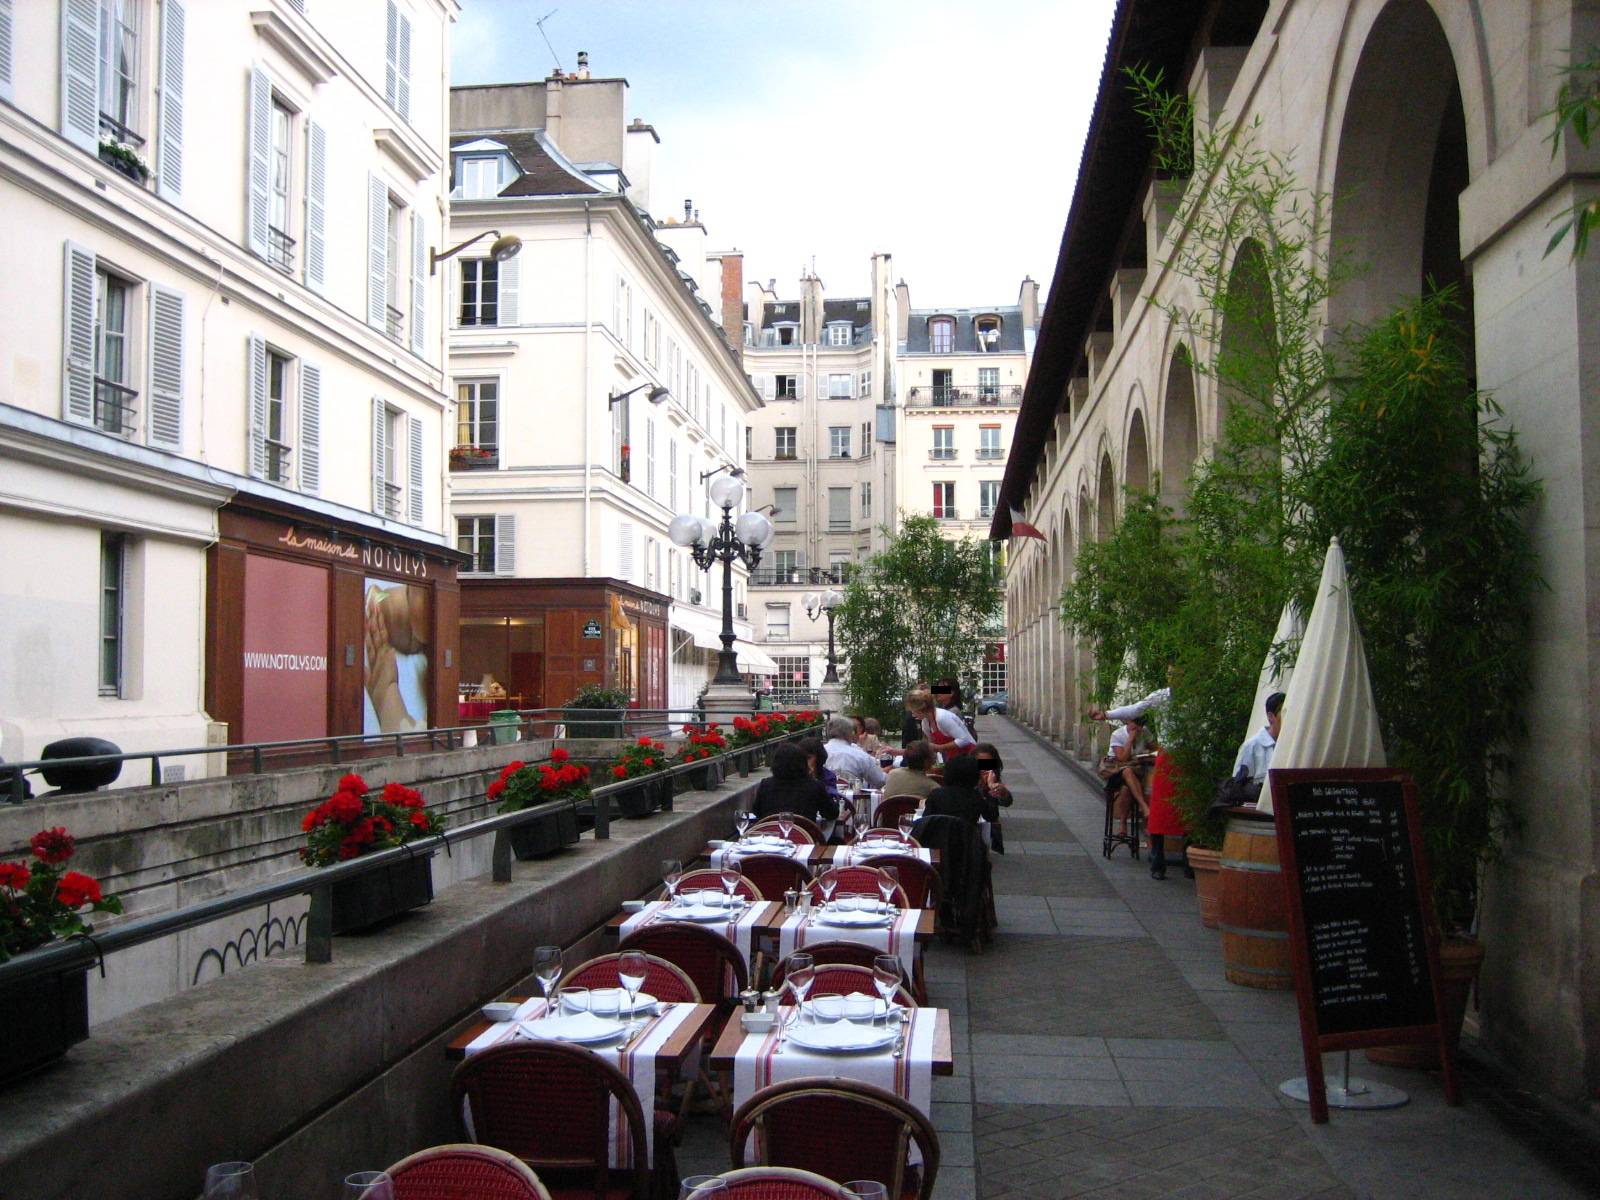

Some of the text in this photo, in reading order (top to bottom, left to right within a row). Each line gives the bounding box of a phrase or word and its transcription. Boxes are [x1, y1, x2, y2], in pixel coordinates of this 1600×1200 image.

[278, 525, 302, 546] la
[304, 536, 343, 557] maison
[362, 545, 428, 578] NATALYS
